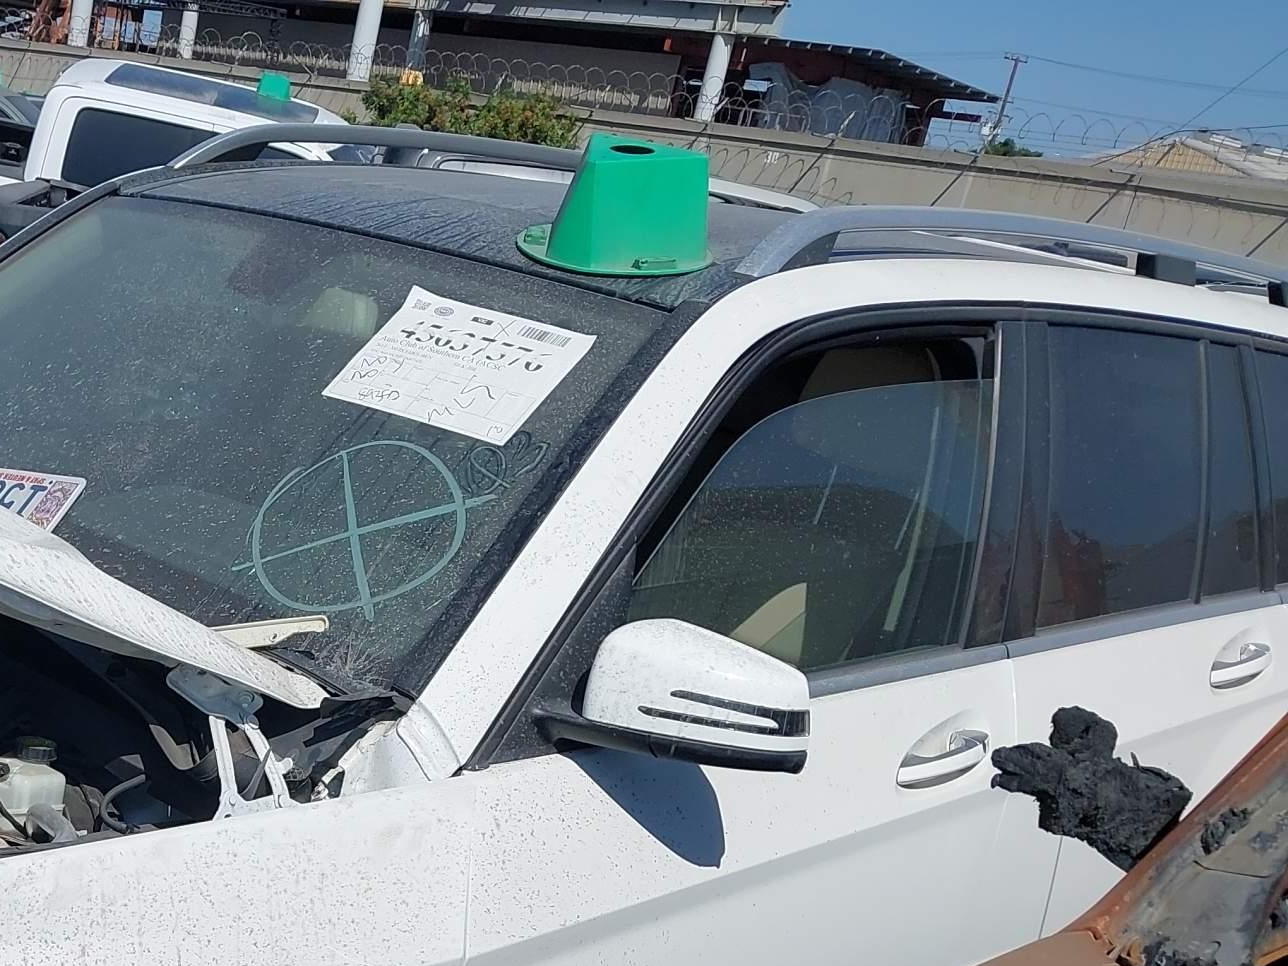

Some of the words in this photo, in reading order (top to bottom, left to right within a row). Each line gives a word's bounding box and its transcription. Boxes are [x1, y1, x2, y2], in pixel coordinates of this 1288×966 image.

[397, 338, 420, 349] Club
[425, 345, 462, 360] Southern
[459, 355, 477, 364] CA
